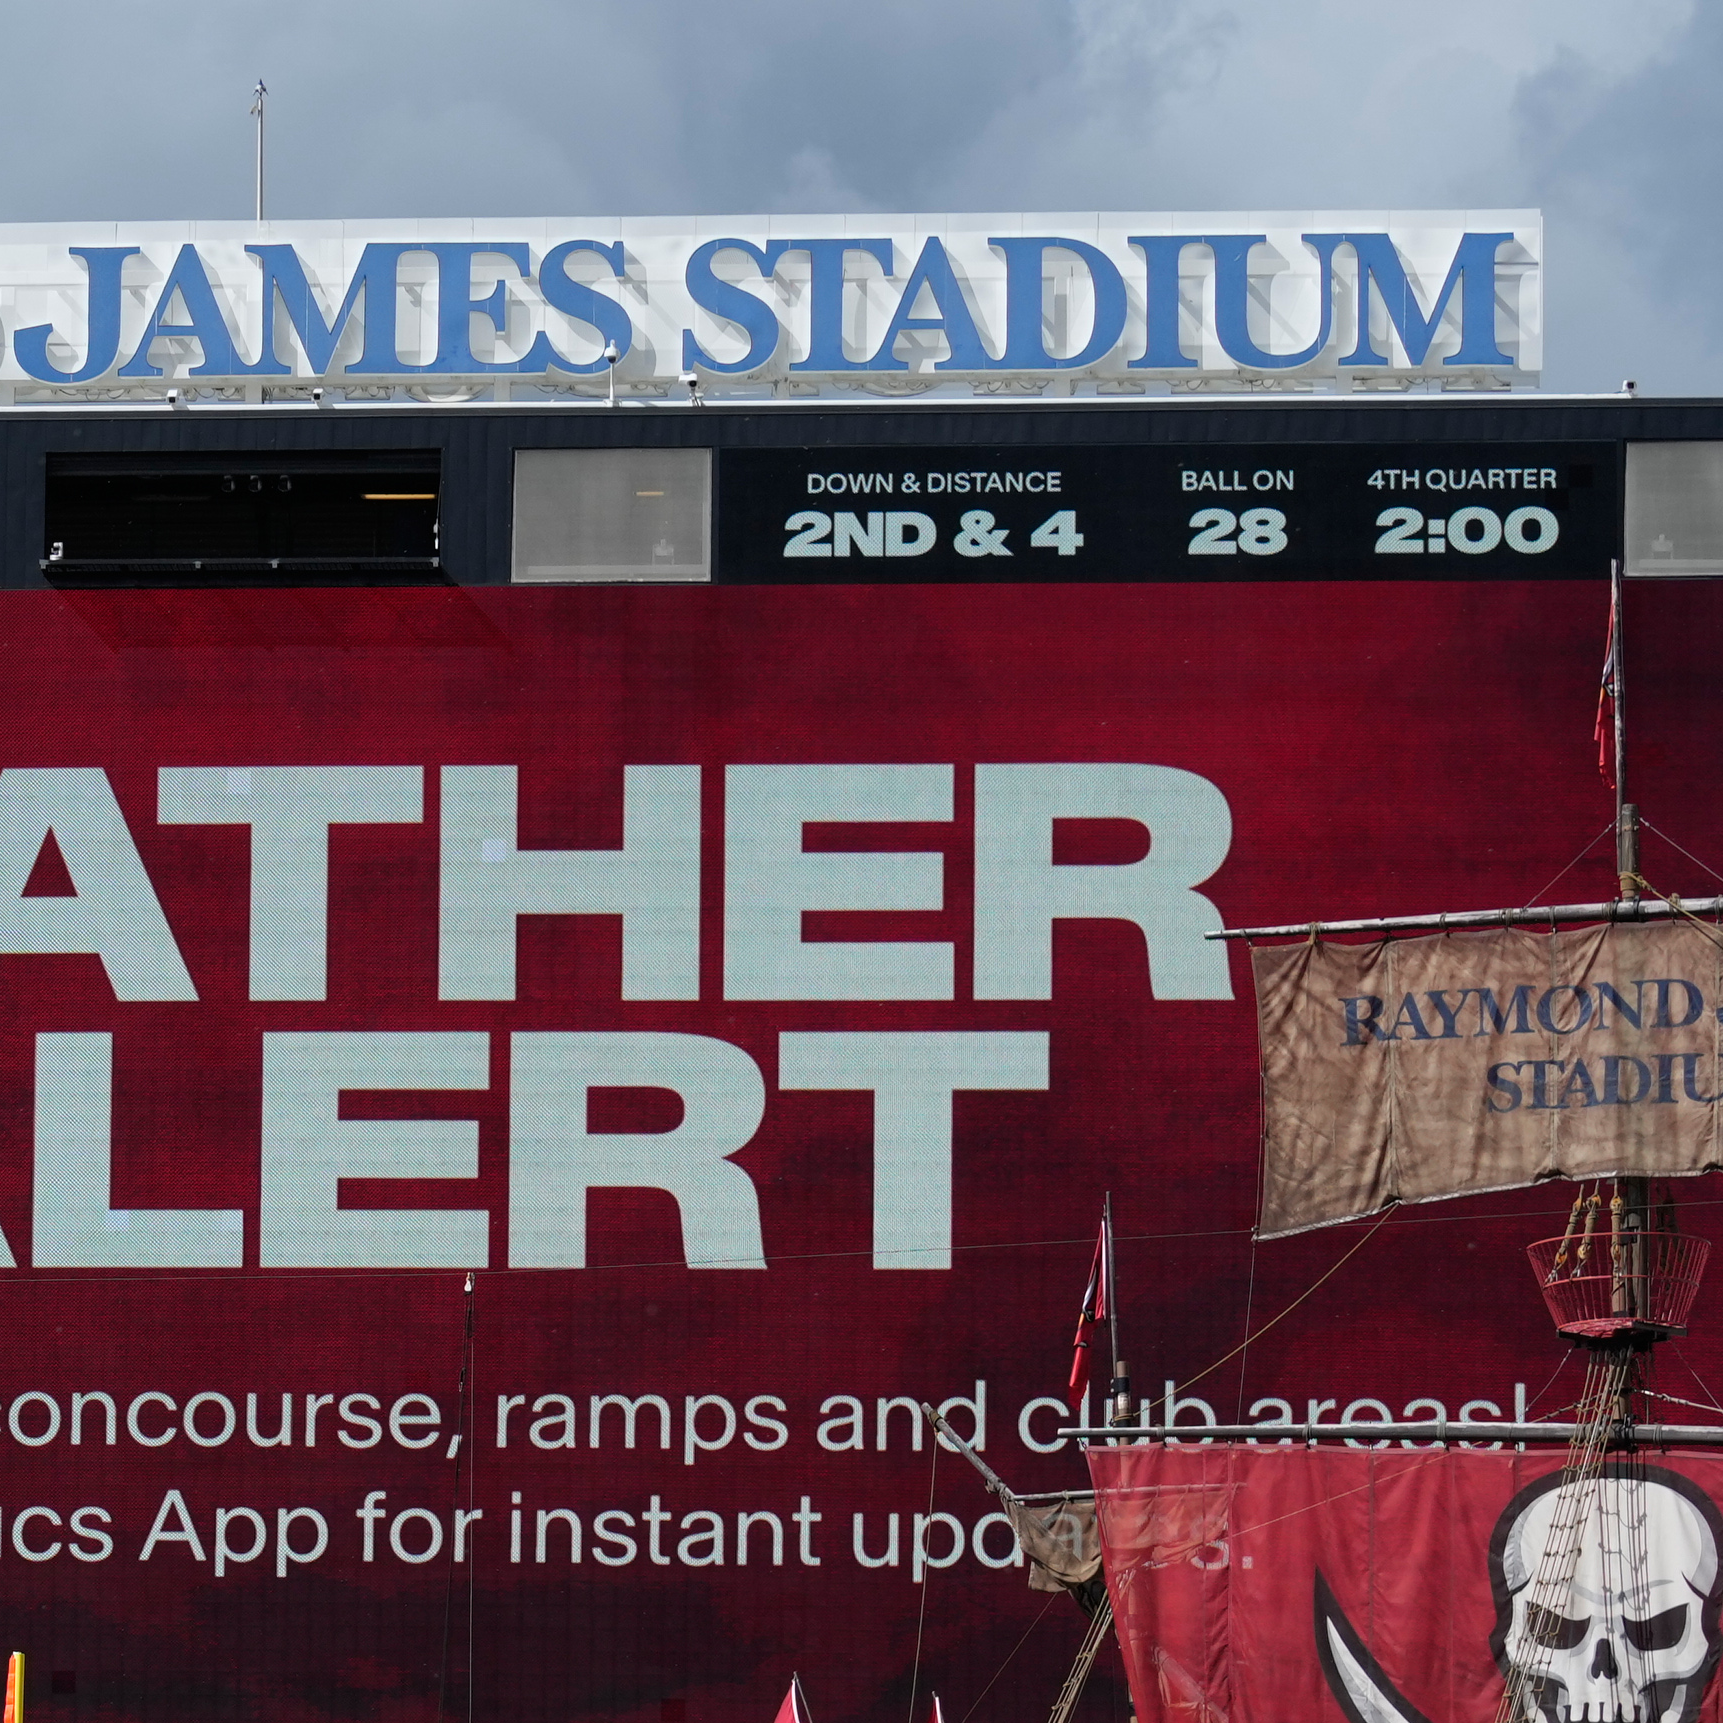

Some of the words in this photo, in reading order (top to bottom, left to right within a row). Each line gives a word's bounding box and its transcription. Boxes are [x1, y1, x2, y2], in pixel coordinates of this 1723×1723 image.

[15, 241, 632, 383] JAMES
[684, 233, 1514, 372] STADIUM
[808, 473, 893, 493] DOWN
[901, 473, 920, 493] &
[928, 472, 1062, 492] DISTANCE
[1181, 470, 1244, 491] BALL
[1251, 470, 1294, 491] ON
[1367, 469, 1421, 490] 4TH
[1425, 468, 1557, 491] QUARTER
[784, 511, 937, 557] 2ND
[954, 510, 1013, 557] &
[1031, 511, 1083, 555] 4
[1188, 508, 1288, 555] 28
[1375, 506, 1559, 554] 2:00
[1339, 978, 1705, 1048] RAYMOND
[496, 1393, 789, 1466] ramps
[816, 1379, 986, 1453] and
[139, 1489, 329, 1578] App
[356, 1490, 483, 1564] for
[510, 1491, 822, 1567] instant
